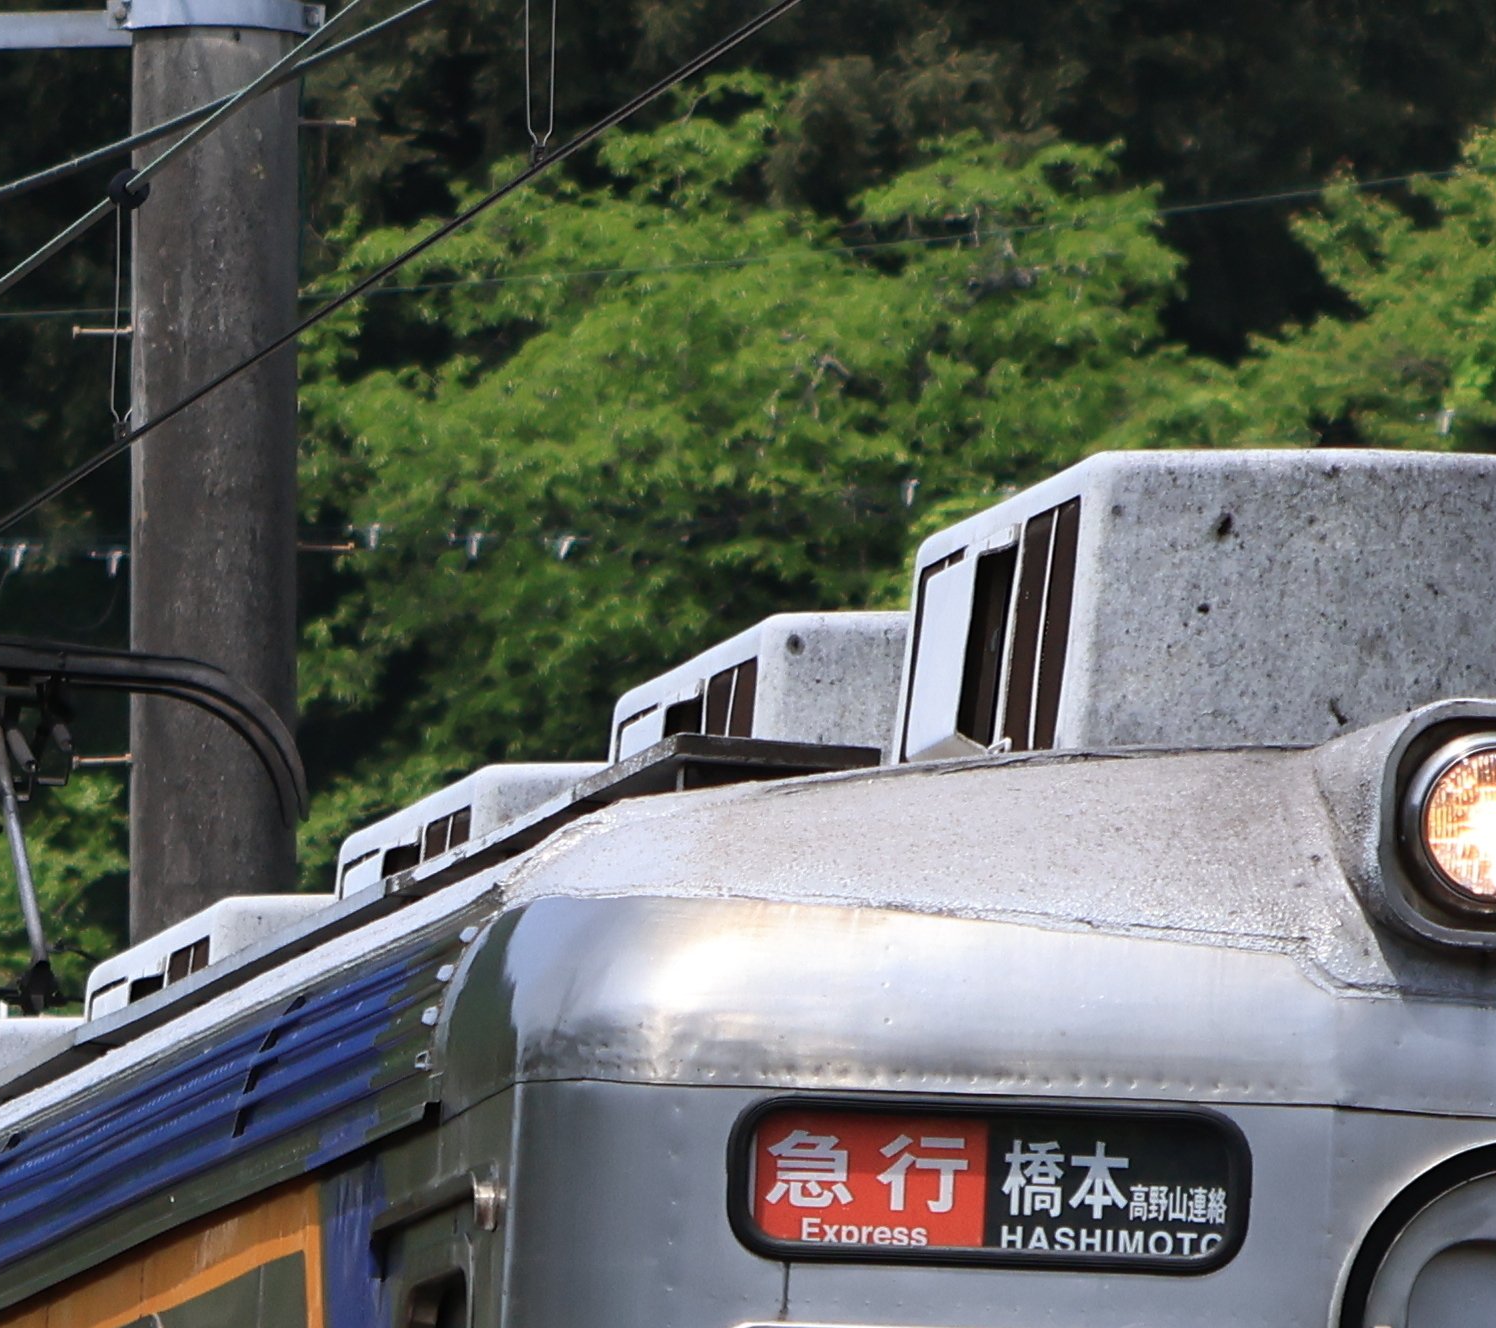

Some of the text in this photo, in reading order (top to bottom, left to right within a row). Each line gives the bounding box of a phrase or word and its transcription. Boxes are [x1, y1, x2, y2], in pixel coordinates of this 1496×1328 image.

[765, 1129, 969, 1213] 急行
[1000, 1139, 1227, 1226] 橋本 高野山連絡
[801, 1217, 929, 1248] Express
